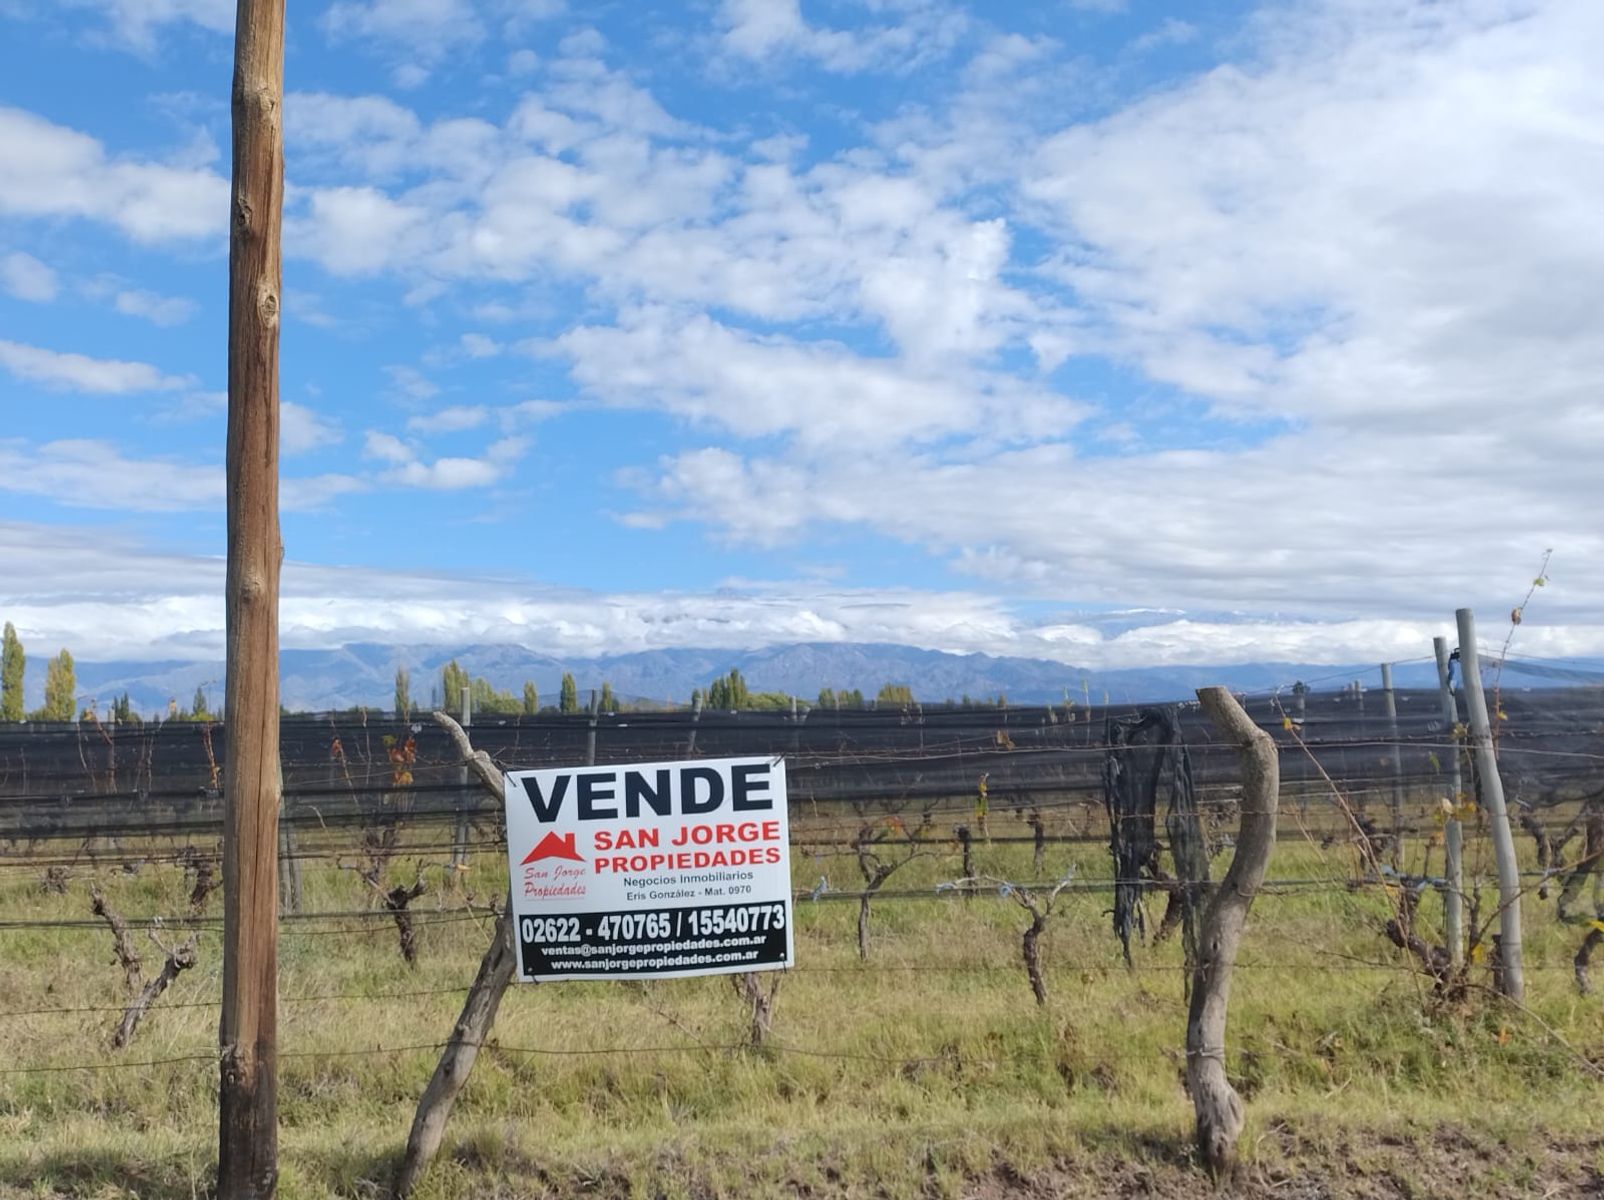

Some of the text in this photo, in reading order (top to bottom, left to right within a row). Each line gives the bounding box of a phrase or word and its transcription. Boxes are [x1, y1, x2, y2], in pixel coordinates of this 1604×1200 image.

[521, 763, 773, 823] VENDE
[594, 821, 780, 850] SAN JORGE
[594, 848, 781, 875] PROPIEDADES
[524, 865, 585, 882] San Jorge
[623, 871, 754, 888] Negocios Inmobiliarios
[524, 881, 587, 899] Propiedades
[626, 891, 646, 901] Eris
[649, 888, 695, 900] González
[705, 886, 725, 897] Mat.
[522, 917, 581, 943] 02622
[597, 911, 671, 941] 470765
[676, 911, 682, 937] /
[688, 904, 785, 935] 15540773
[541, 935, 767, 957] ventas@sanjorgepropiedades.com.ar
[551, 950, 759, 970] www.sanjorgepropiedades.com.ar
